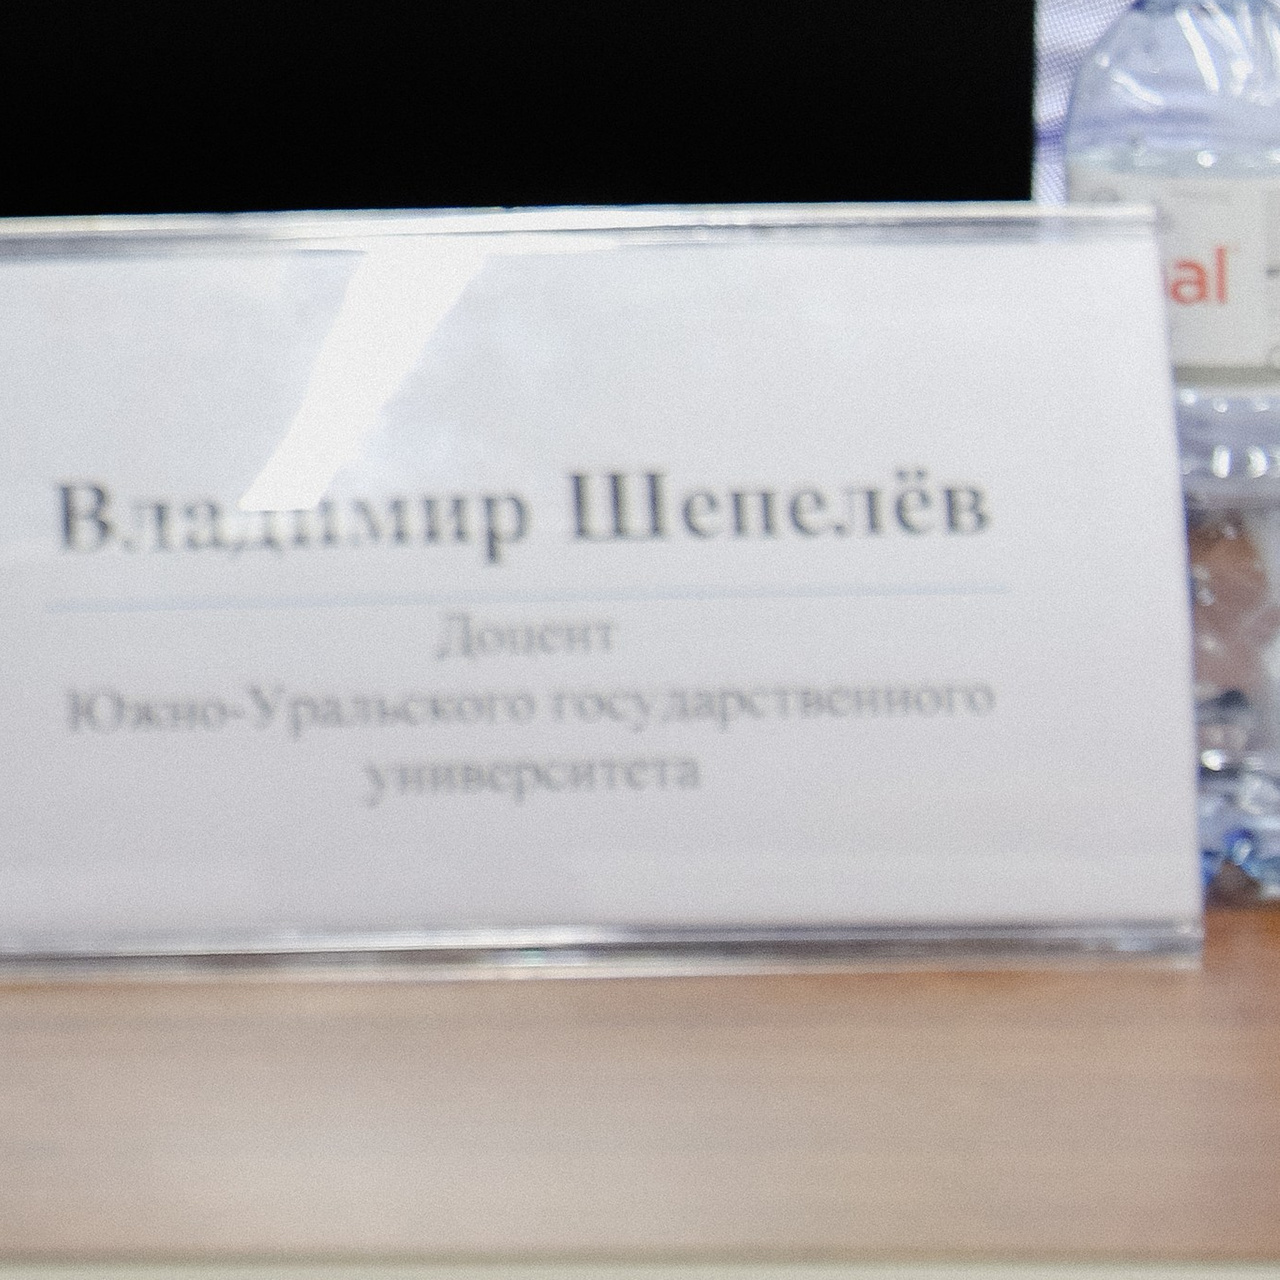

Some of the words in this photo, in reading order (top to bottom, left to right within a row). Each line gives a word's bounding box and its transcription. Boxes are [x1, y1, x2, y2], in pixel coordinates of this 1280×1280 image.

[1166, 245, 1229, 307] al
[56, 480, 532, 566] Владимир
[566, 466, 992, 542] Шепелёв
[435, 610, 616, 661] Доцент
[66, 681, 536, 740] Южно-Уральского
[552, 679, 998, 736] государственного
[363, 756, 703, 810] университета
